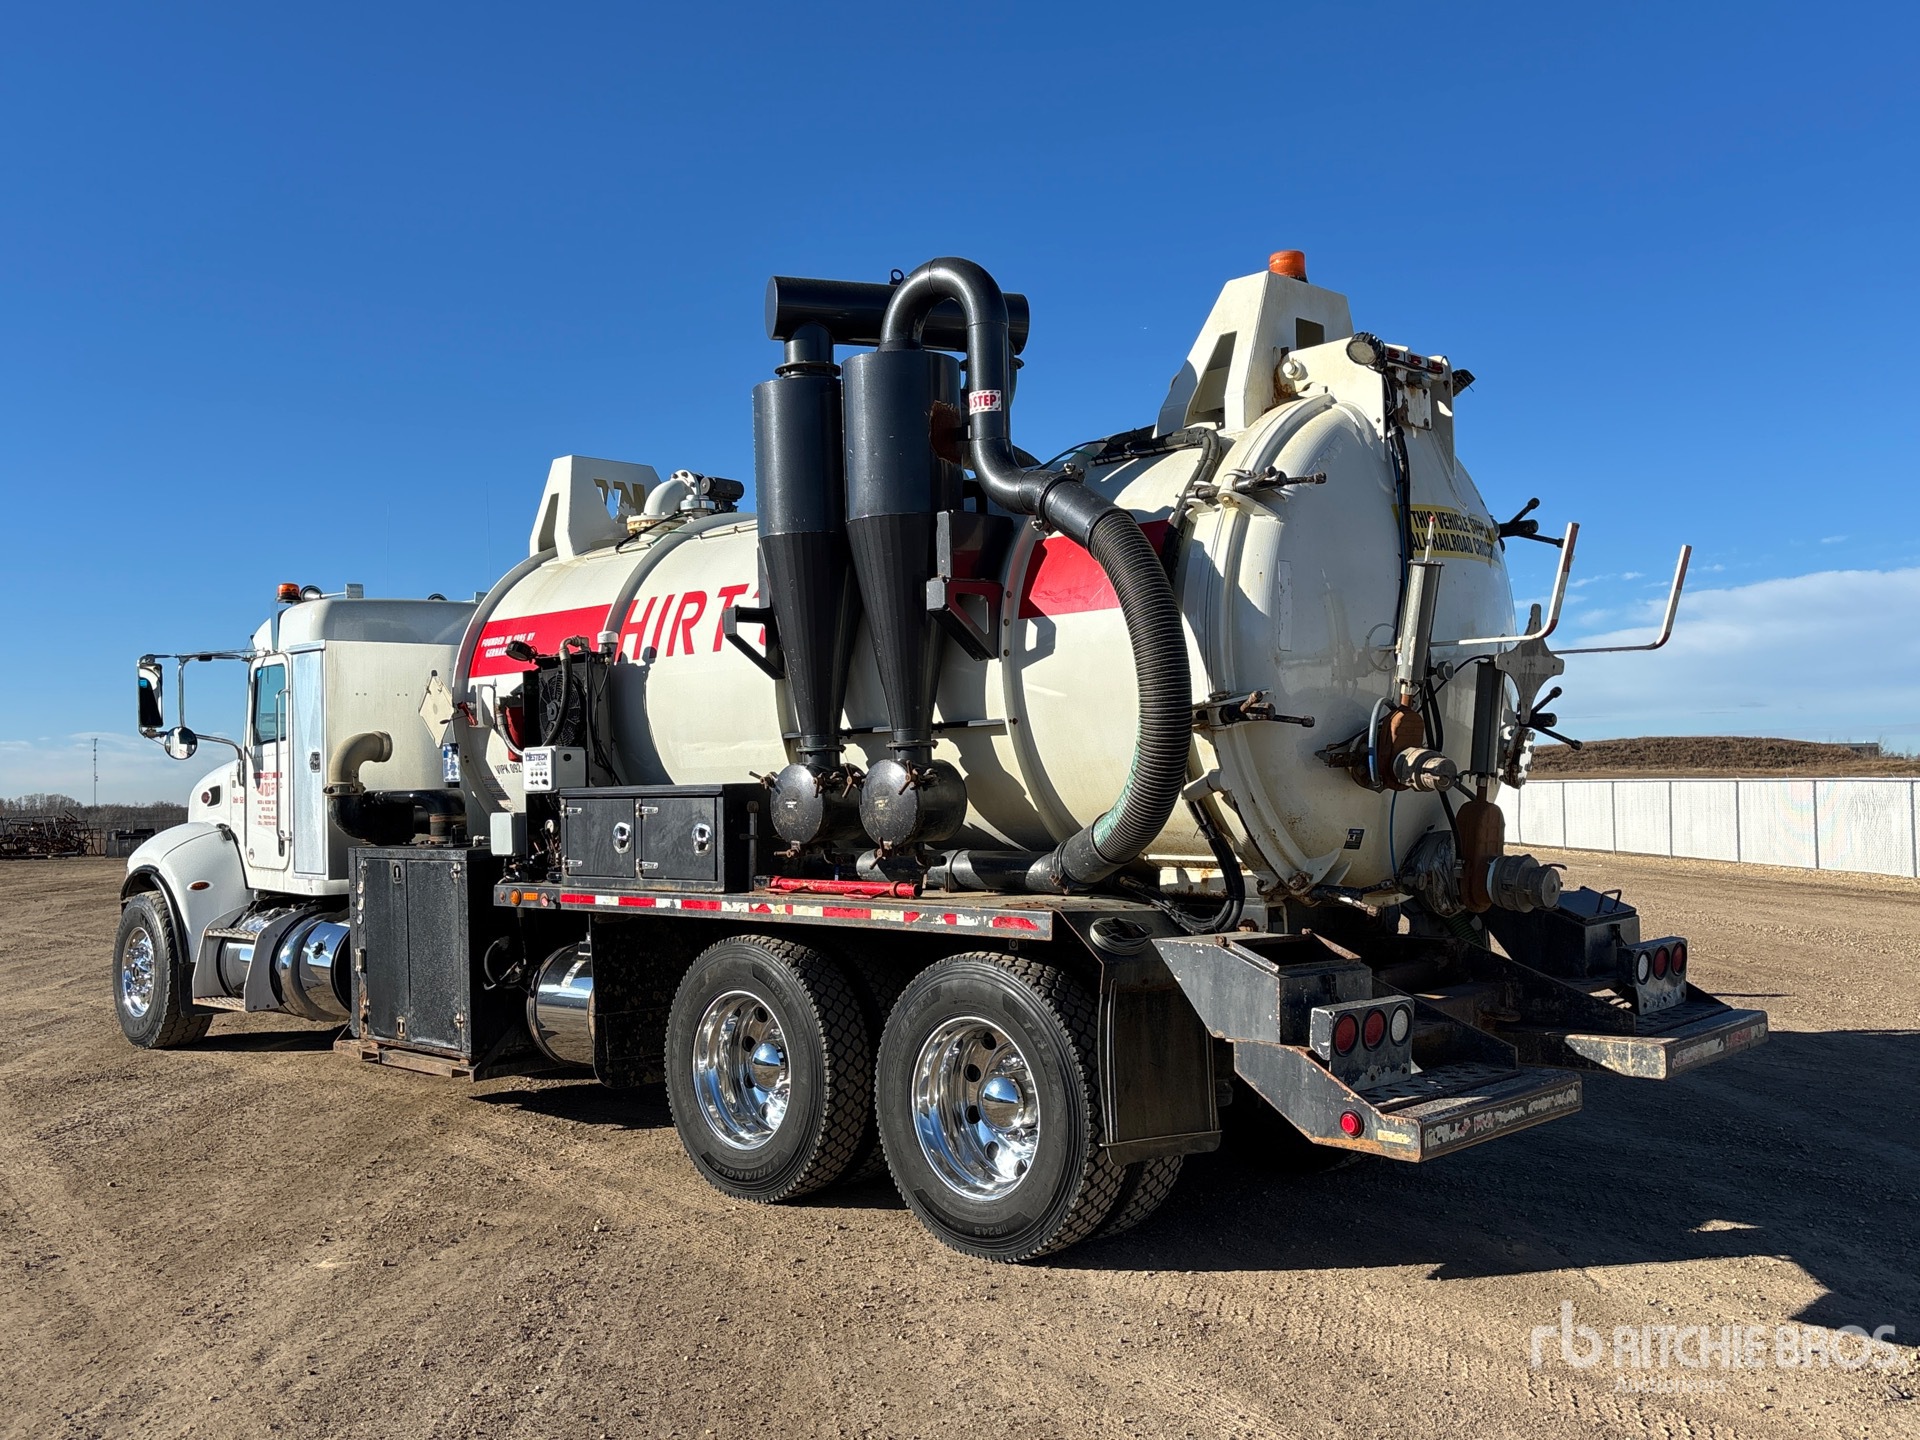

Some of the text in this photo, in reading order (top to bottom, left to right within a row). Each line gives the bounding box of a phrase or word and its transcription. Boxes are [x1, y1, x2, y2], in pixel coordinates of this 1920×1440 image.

[973, 394, 997, 408] STEP
[1435, 511, 1470, 533] VEHICLE
[1432, 533, 1474, 554] RAILROAD
[615, 583, 766, 664] HIRT
[711, 1161, 774, 1181] TRIANGLE
